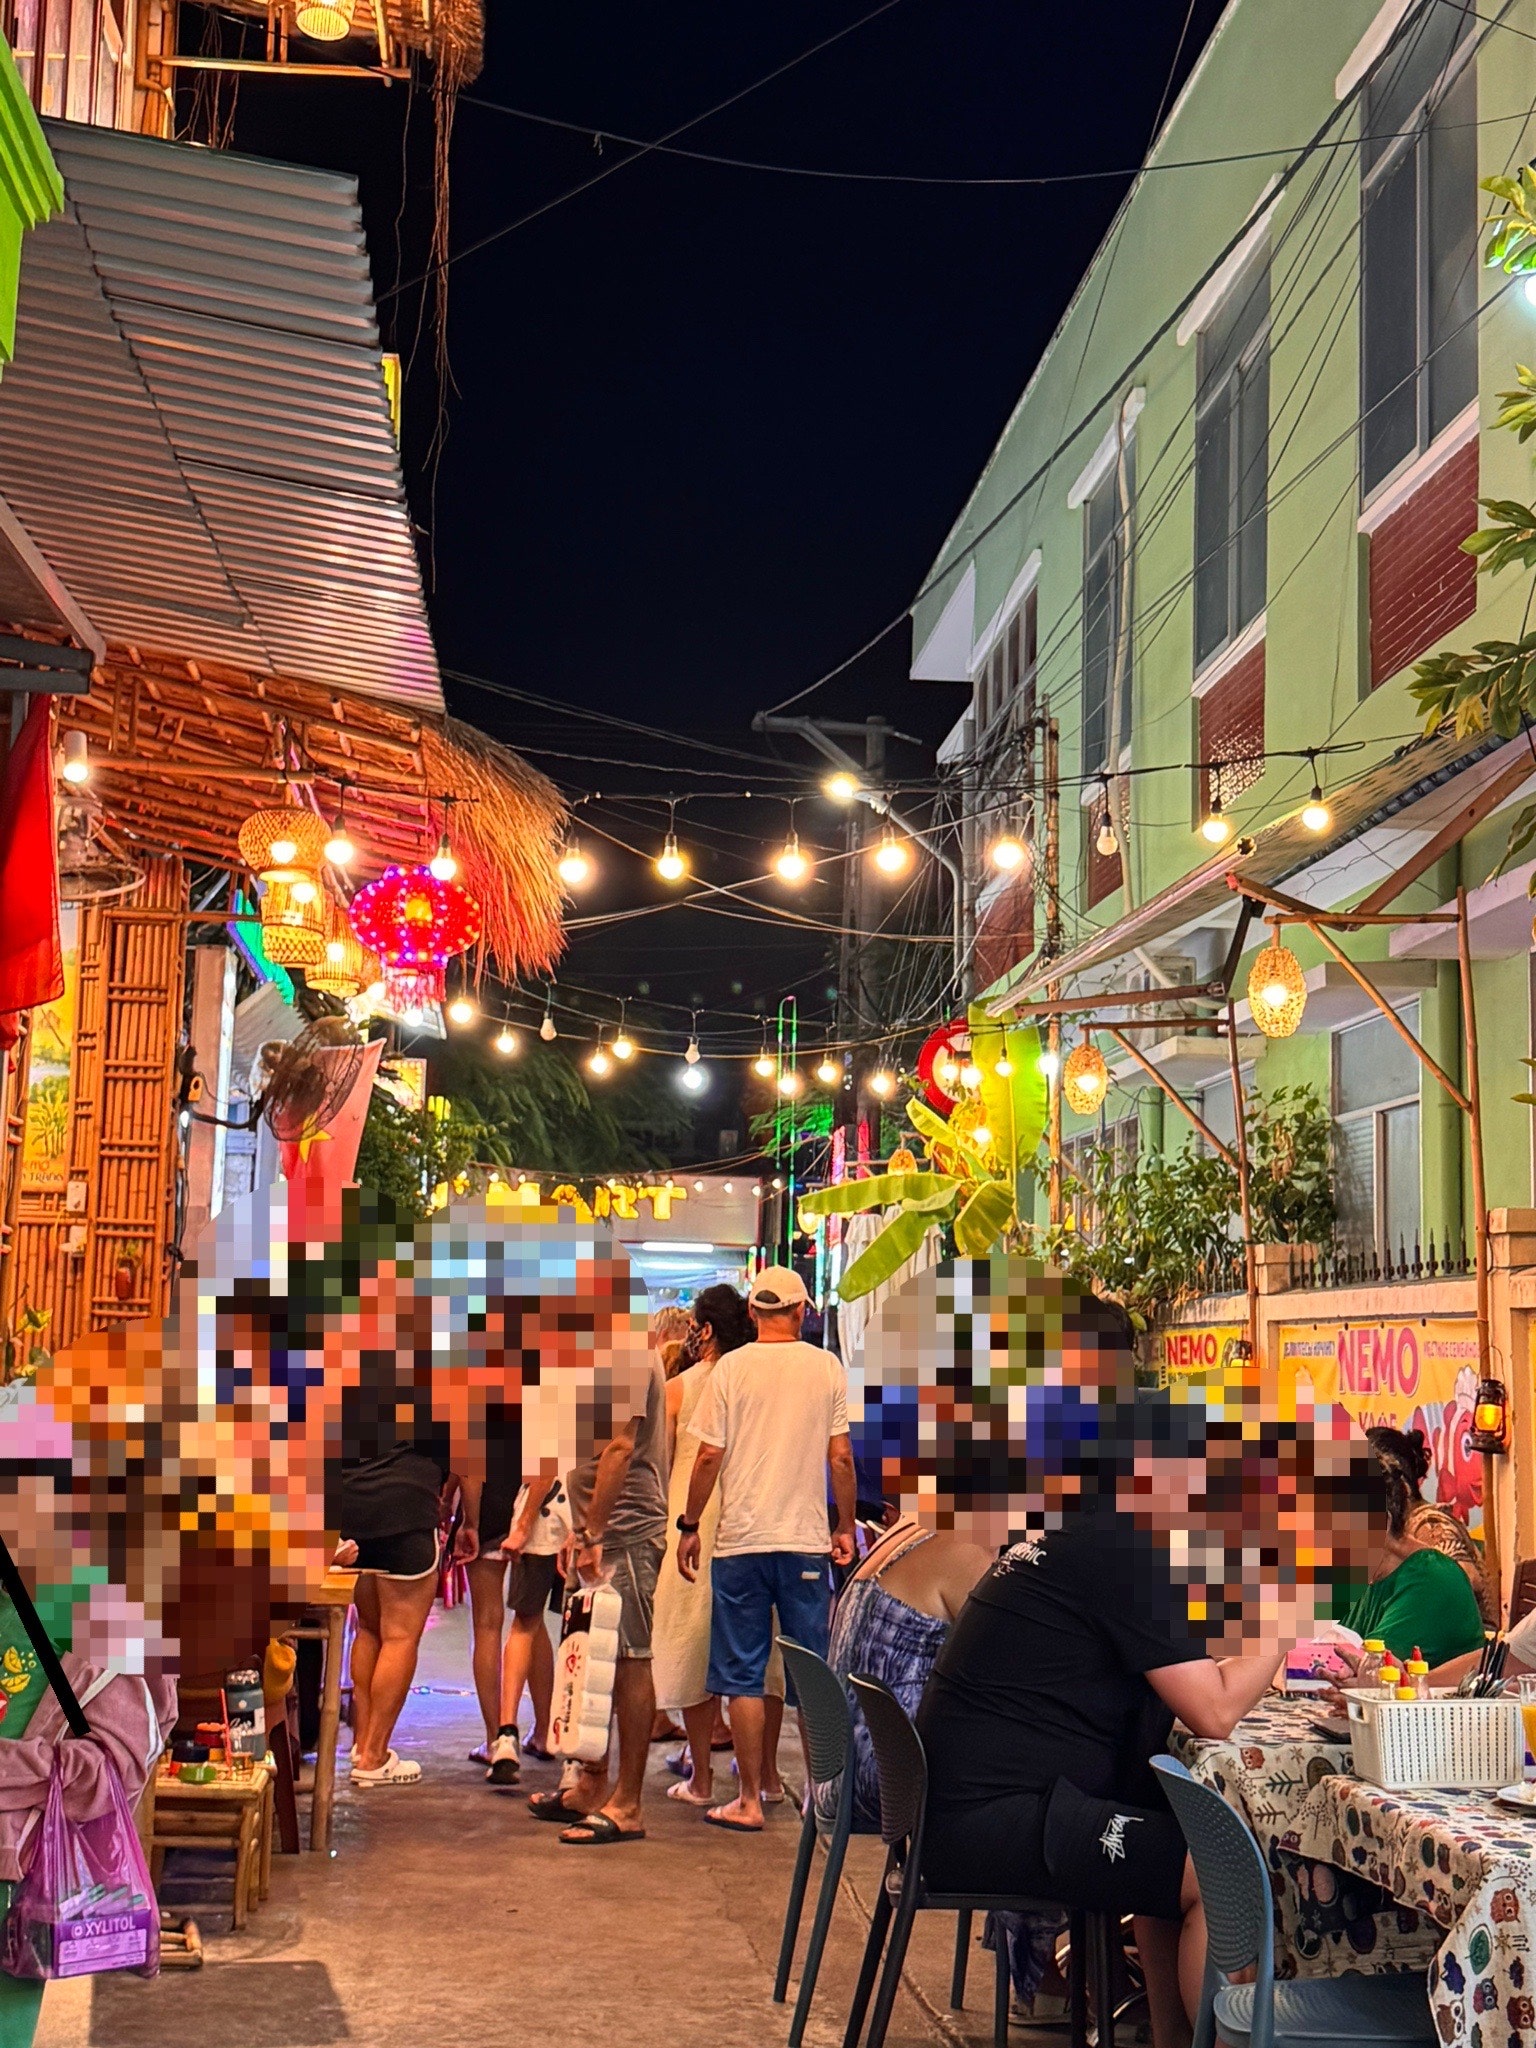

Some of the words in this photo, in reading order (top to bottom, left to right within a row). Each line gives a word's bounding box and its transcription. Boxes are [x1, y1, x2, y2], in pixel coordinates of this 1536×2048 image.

[1166, 1333, 1218, 1366] NEMO
[1338, 1327, 1420, 1397] NEMO
[85, 1916, 136, 1937] XYLITOL
